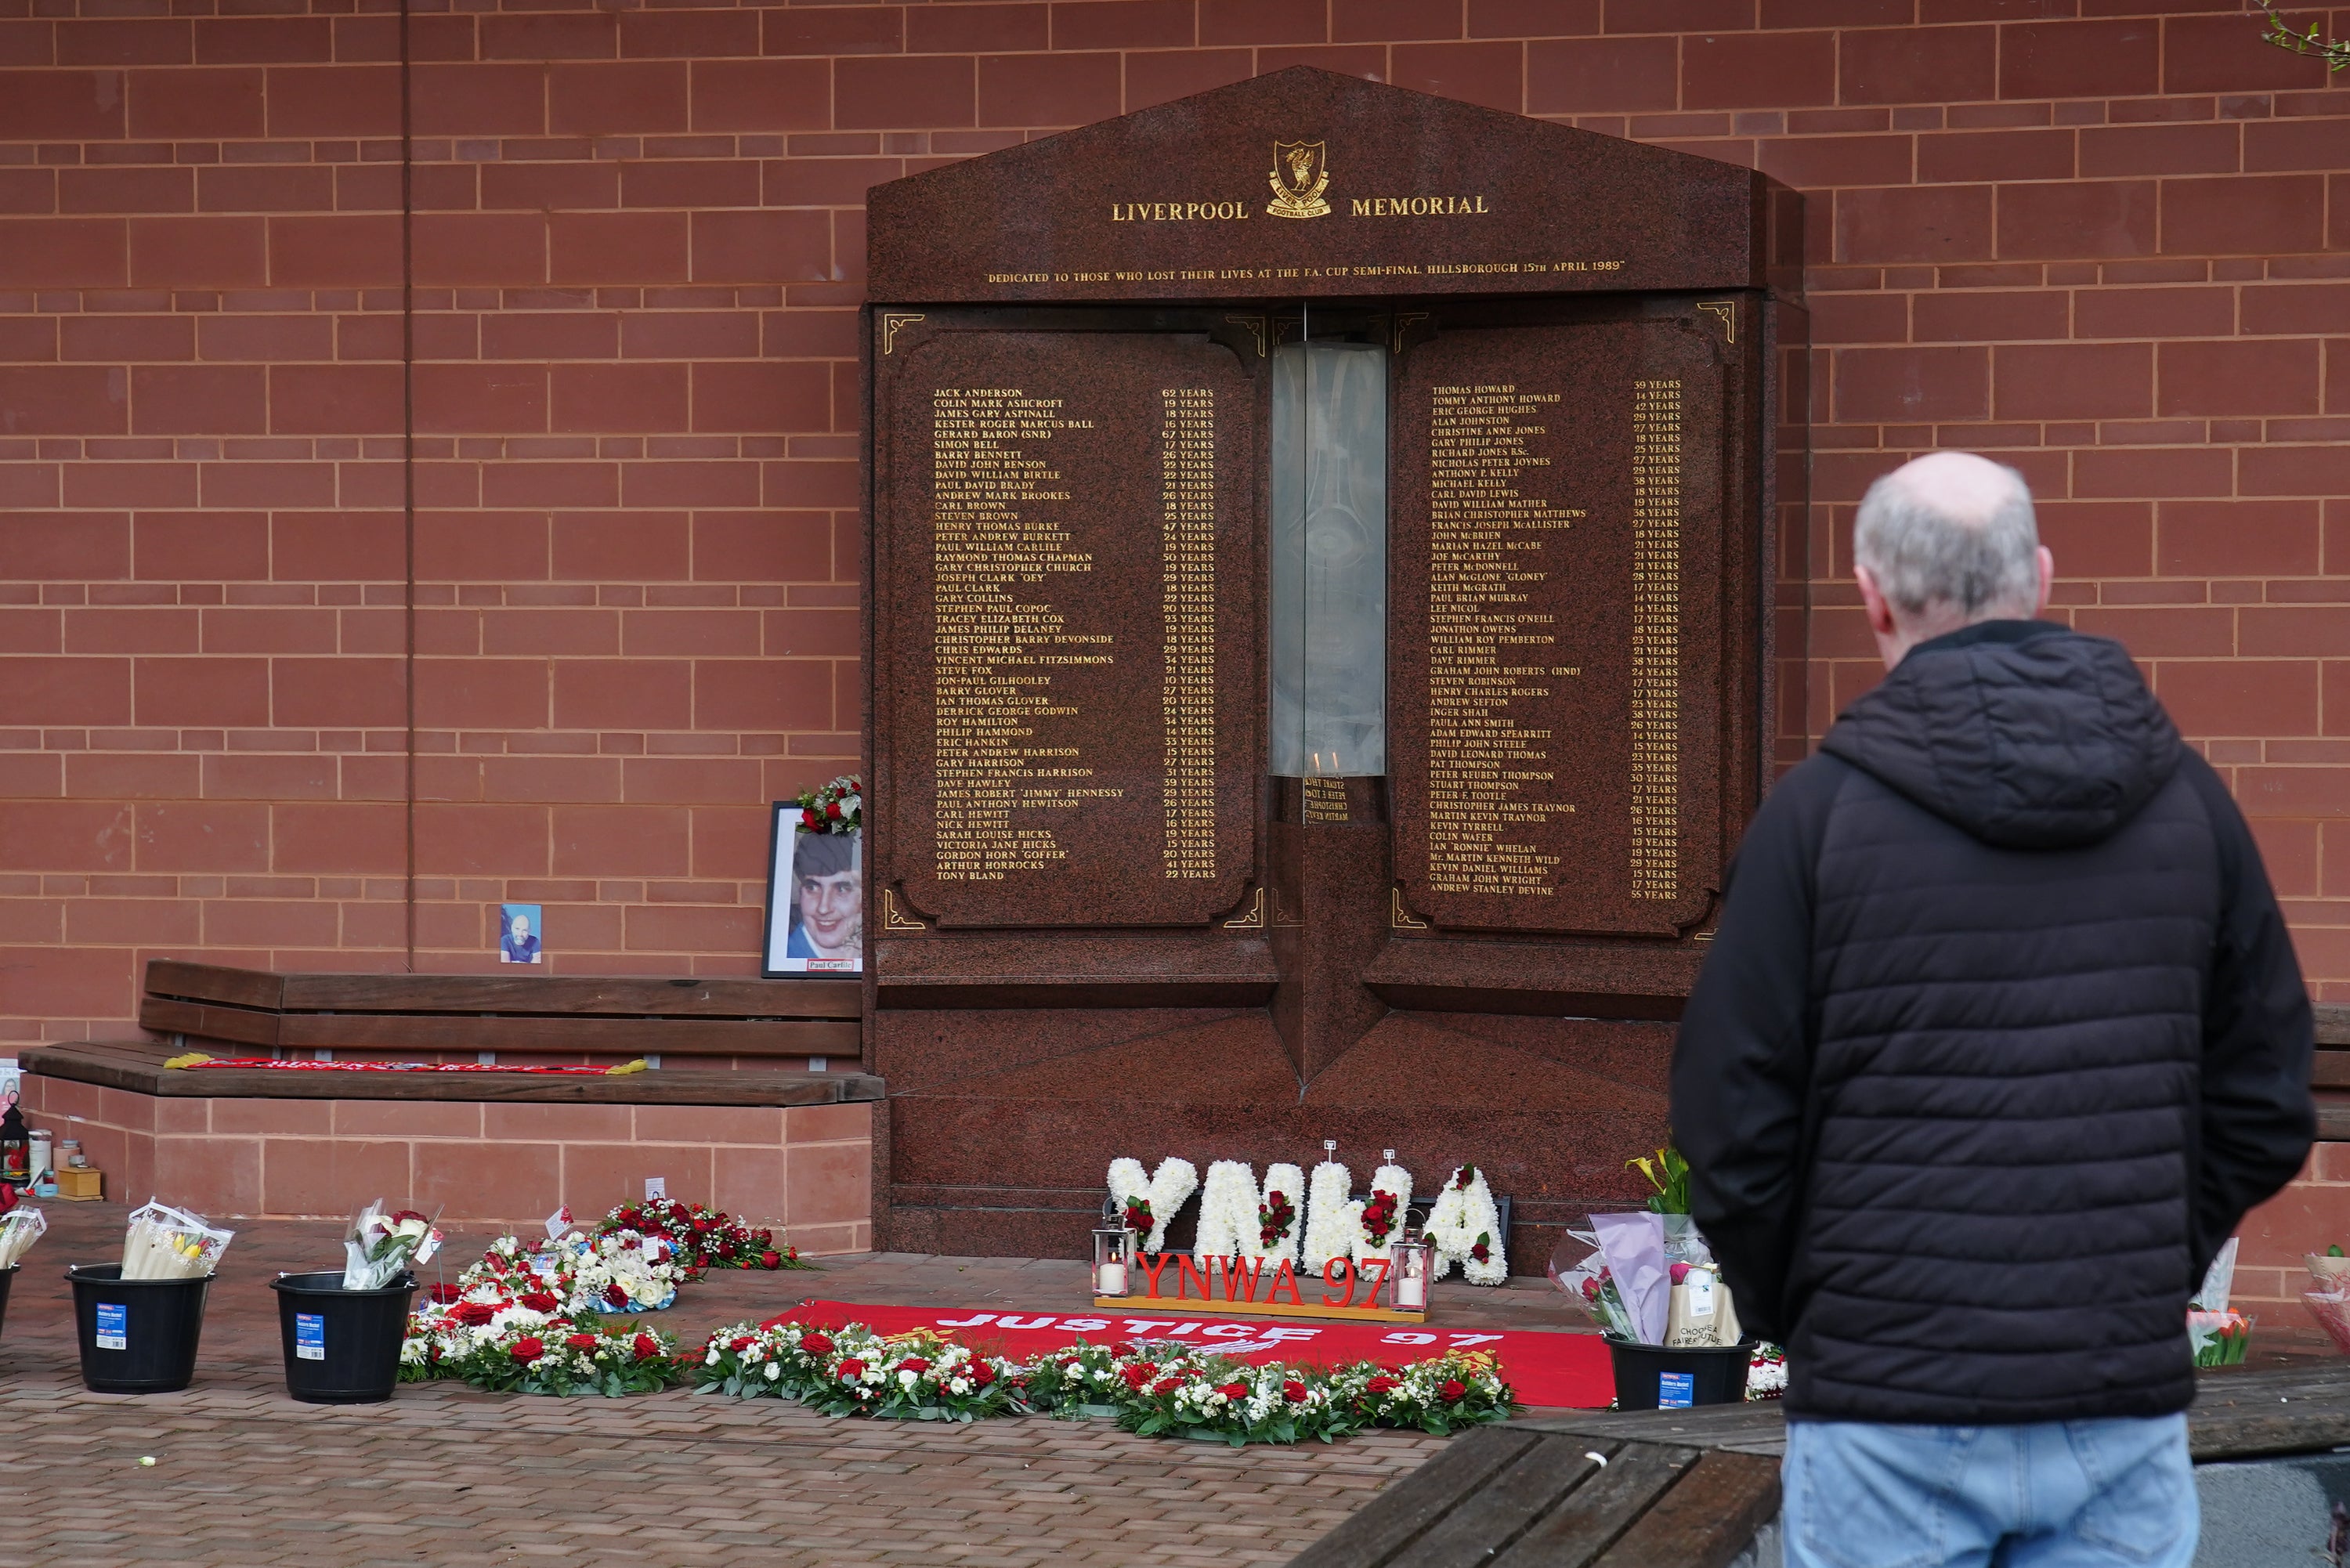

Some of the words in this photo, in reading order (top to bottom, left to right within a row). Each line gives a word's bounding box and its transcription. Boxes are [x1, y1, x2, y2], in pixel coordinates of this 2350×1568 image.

[1275, 186, 1297, 206] LIVER
[1301, 188, 1321, 206] POOL
[1112, 201, 1249, 221] LIVERPOOL
[1350, 197, 1488, 217] MEMORIAL
[1272, 208, 1306, 217] FOOTBALL
[1307, 208, 1324, 217] CLUB
[1054, 273, 1068, 283] TO
[1073, 273, 1110, 282] THOSE
[1115, 271, 1143, 281] WHO
[1148, 271, 1175, 280] LOST
[1180, 270, 1215, 280] THEIR
[1220, 269, 1253, 279] LIVES
[1258, 269, 1271, 279] AT
[1276, 269, 1299, 278] THE
[1304, 268, 1321, 277] F.A.
[1325, 267, 1349, 276] CUP
[1427, 263, 1519, 274] HILLSBOROUGH
[1553, 262, 1588, 272] APRIL
[934, 388, 960, 397] JACK
[964, 388, 1022, 397] ANDERSON
[1162, 388, 1177, 397] 62
[1179, 388, 1213, 397] YEARS
[1432, 396, 1466, 405] TOMMY
[1470, 395, 1516, 404] ANTHONY
[1519, 393, 1560, 403] HOWARD
[1636, 392, 1647, 400] 14
[1649, 390, 1680, 399] YEARS
[935, 420, 975, 428] KESTER
[979, 420, 1016, 428] ROGER
[1020, 420, 1065, 428] MARCUS
[1068, 420, 1094, 428] BALL
[1165, 420, 1176, 428] 16
[1179, 420, 1213, 428] YEARS
[1430, 427, 1483, 436] CHRISTINE
[1486, 426, 1513, 435] ANNE
[1514, 425, 1546, 435] JONES
[1633, 423, 1646, 433] 27
[1648, 422, 1680, 432] YEARS
[935, 450, 970, 459] BARRY
[974, 450, 1022, 459] BENNETT
[1162, 450, 1177, 459] 26
[1180, 450, 1214, 459] YEARS
[1431, 458, 1479, 468] NICHOLAS
[1481, 457, 1510, 467] PETER
[1513, 457, 1550, 466] JOYNES
[1632, 455, 1646, 464] 27
[1648, 454, 1680, 464] YEARS
[935, 491, 981, 500] ANDREW
[985, 491, 1017, 500] MARK
[1021, 491, 1071, 500] BROOKES
[1162, 491, 1176, 500] 26
[1180, 491, 1214, 500] YEARS
[1462, 500, 1505, 508] WILLIAM
[1508, 499, 1547, 508] MATHER
[1634, 497, 1645, 507] 19
[1648, 497, 1679, 506] YEARS
[1506, 541, 1542, 550] McCABE
[1647, 540, 1679, 548] YEARS
[935, 563, 964, 572] GARY
[966, 563, 1043, 572] CHRISTOPHER
[1046, 563, 1091, 572] CHURCH
[1165, 562, 1177, 572] 19
[1180, 563, 1214, 572] YEARS
[1430, 594, 1453, 602] PAUL
[1455, 594, 1485, 602] BRIAN
[1488, 593, 1528, 602] MURRAY
[1647, 593, 1679, 602] YEARS
[1042, 614, 1065, 623] COX
[1164, 614, 1177, 623] 23
[1180, 614, 1214, 623] YEARS
[1430, 635, 1472, 644] WILLIAM
[1476, 635, 1495, 644] ROY
[1499, 635, 1554, 644] PEMBERTON
[1632, 635, 1644, 645] 23
[1646, 635, 1678, 645] YEARS
[935, 656, 983, 664] VINCENT
[986, 656, 1036, 664] MICHAEL
[1039, 655, 1114, 664] FITZSIMMONS
[1164, 655, 1177, 663] 34
[1180, 655, 1215, 663] YEARS
[1430, 687, 1462, 695] HENRY
[1511, 688, 1549, 696] ROGERS
[1632, 688, 1643, 698] 17
[1646, 688, 1678, 698] YEARS
[935, 696, 955, 706] IAN
[958, 696, 1003, 706] THOMAS
[1007, 696, 1049, 706] GLOVER
[1162, 696, 1177, 705] 20
[1180, 695, 1214, 704] YEARS
[1430, 728, 1456, 737] ADAM
[1500, 729, 1552, 739] SPEARRITT
[1646, 732, 1678, 740] YEARS
[936, 748, 969, 757] PETER
[972, 748, 1019, 757] ANDREW
[1023, 747, 1079, 757] HARRISON
[1166, 747, 1177, 756] 15
[1180, 747, 1215, 756] YEARS
[1430, 770, 1458, 779] PETER
[1462, 770, 1499, 779] REUBEN
[1502, 771, 1554, 780] THOMPSON
[1629, 773, 1643, 782] 30
[1646, 774, 1677, 782] YEARS
[936, 800, 962, 808] PAUL
[965, 800, 1018, 808] ANTHONY
[1021, 799, 1079, 807] HEWITSON
[1163, 798, 1177, 807] 26
[1180, 798, 1214, 807] YEARS
[1430, 811, 1466, 820] MARTIN
[1470, 812, 1499, 821] KEVIN
[1502, 812, 1546, 822] TRAYNOR
[1632, 816, 1643, 825] 16
[1645, 816, 1677, 826] YEARS
[936, 861, 981, 870] ARTHUR
[985, 860, 1044, 869] HORROCKS
[1180, 859, 1215, 869] YEARS
[1430, 883, 1470, 892] ANDREW
[1473, 884, 1514, 894] STANLEY
[1518, 886, 1554, 895] DEVINE
[1631, 889, 1642, 898] 55
[1643, 890, 1677, 900] YEARS
[1135, 1252, 1305, 1306] YNWA
[1322, 1257, 1391, 1309] 97
[937, 1314, 1323, 1341] JUSTICE
[1380, 1332, 1505, 1347] 97
